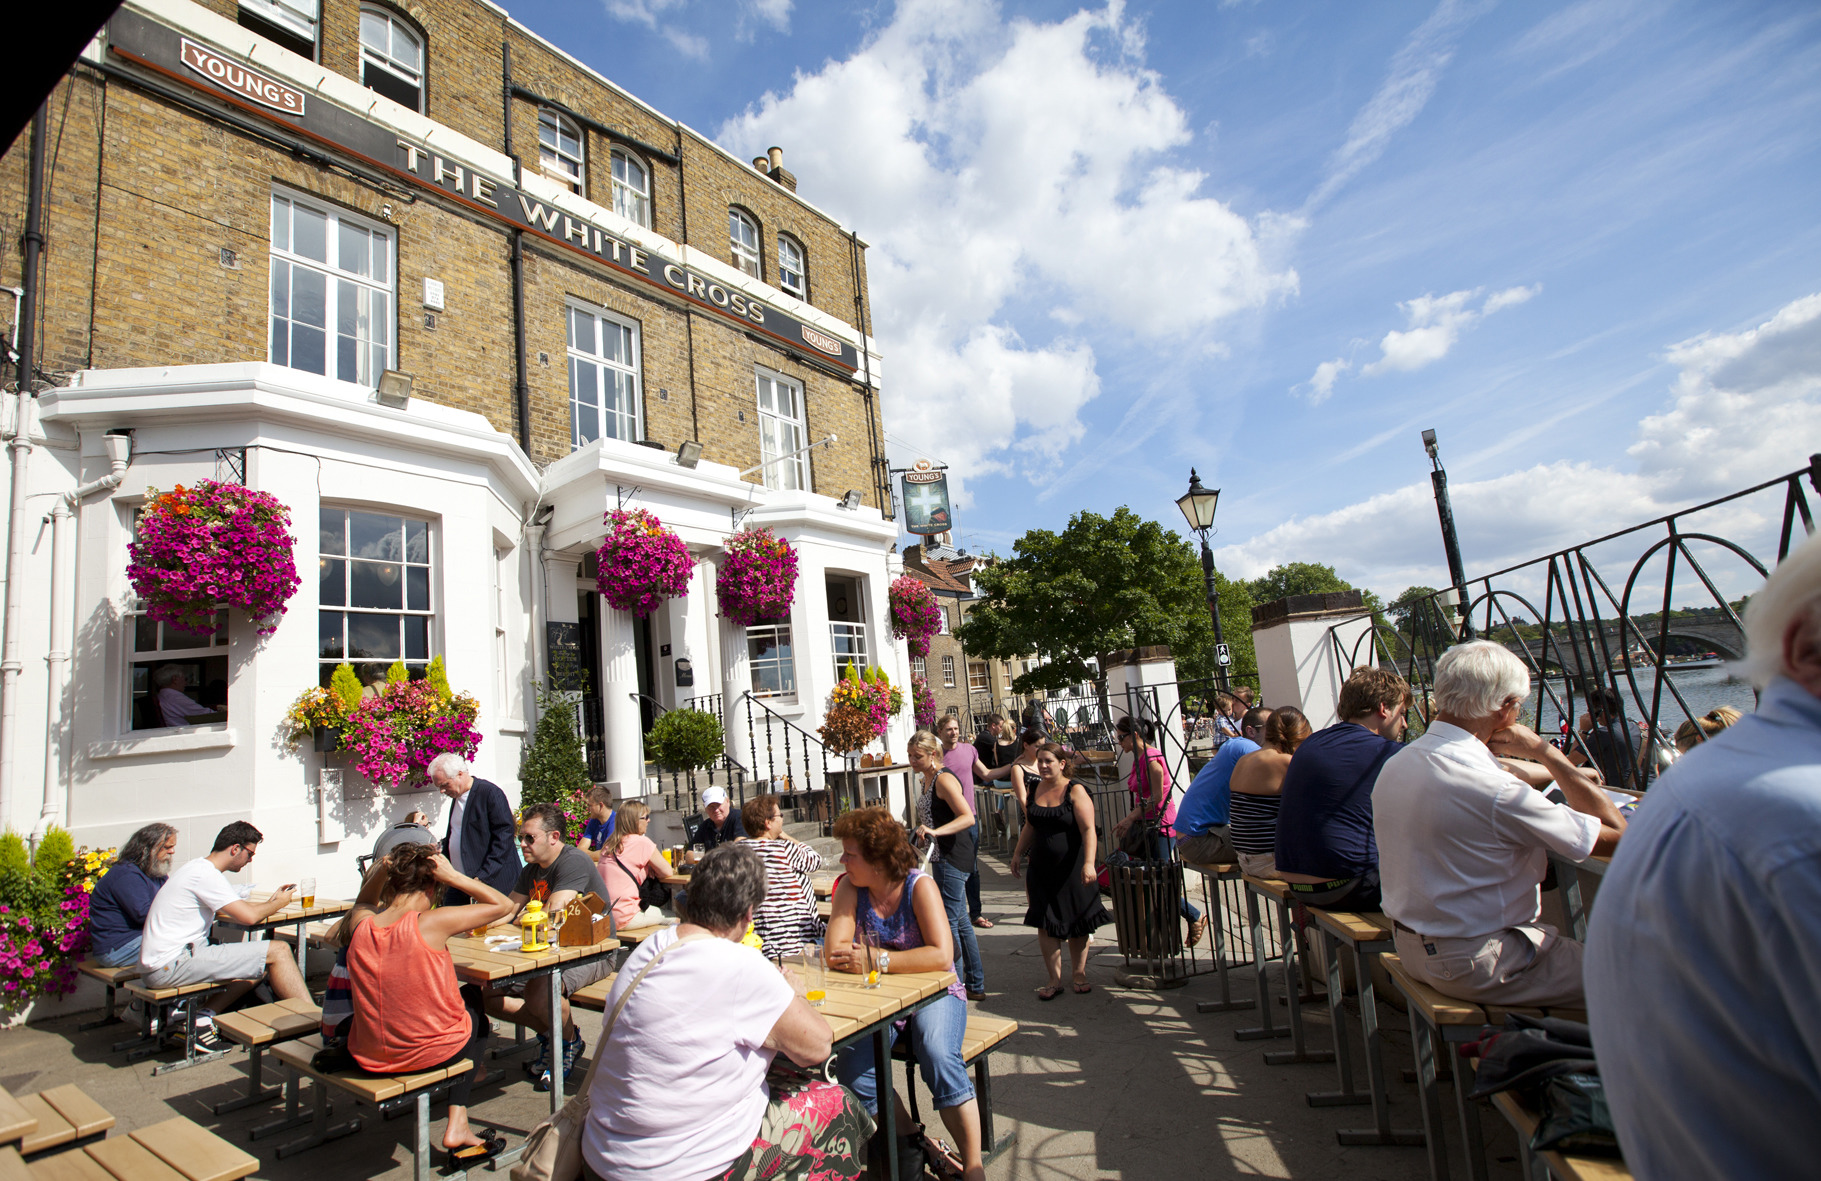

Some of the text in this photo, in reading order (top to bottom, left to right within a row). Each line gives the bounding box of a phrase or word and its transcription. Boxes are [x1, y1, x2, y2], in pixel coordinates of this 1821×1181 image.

[191, 48, 296, 108] YOUNG'S
[396, 140, 765, 325] THE WHITE CROSS
[804, 329, 839, 352] YOUNG'S
[909, 473, 939, 481] YOUNG'S
[1293, 884, 1314, 892] PUMA
[568, 904, 581, 916] 26
